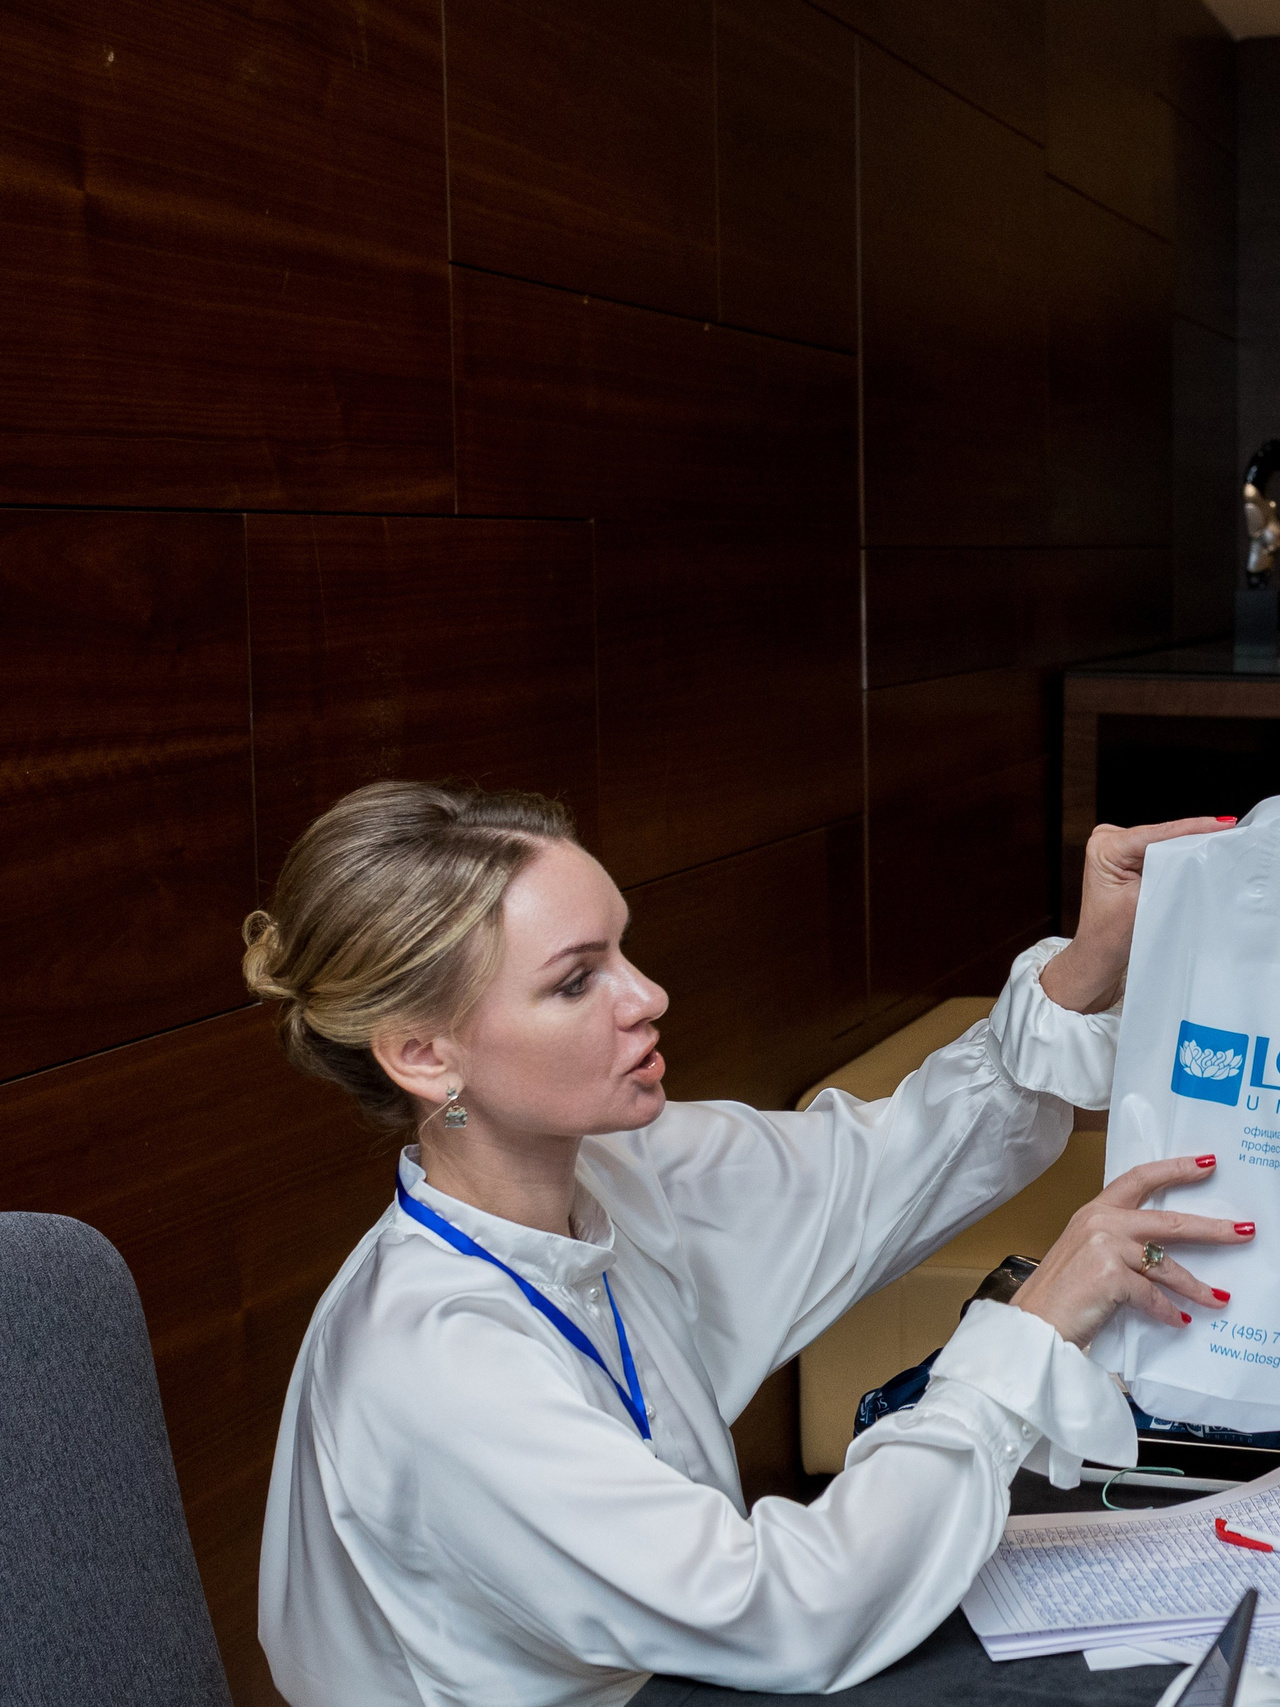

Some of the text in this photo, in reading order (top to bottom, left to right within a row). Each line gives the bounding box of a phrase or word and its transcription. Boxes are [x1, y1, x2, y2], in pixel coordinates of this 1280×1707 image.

[1238, 1153, 1247, 1162] и
[1210, 1319, 1229, 1333] +7
[1231, 1323, 1268, 1345] (495)
